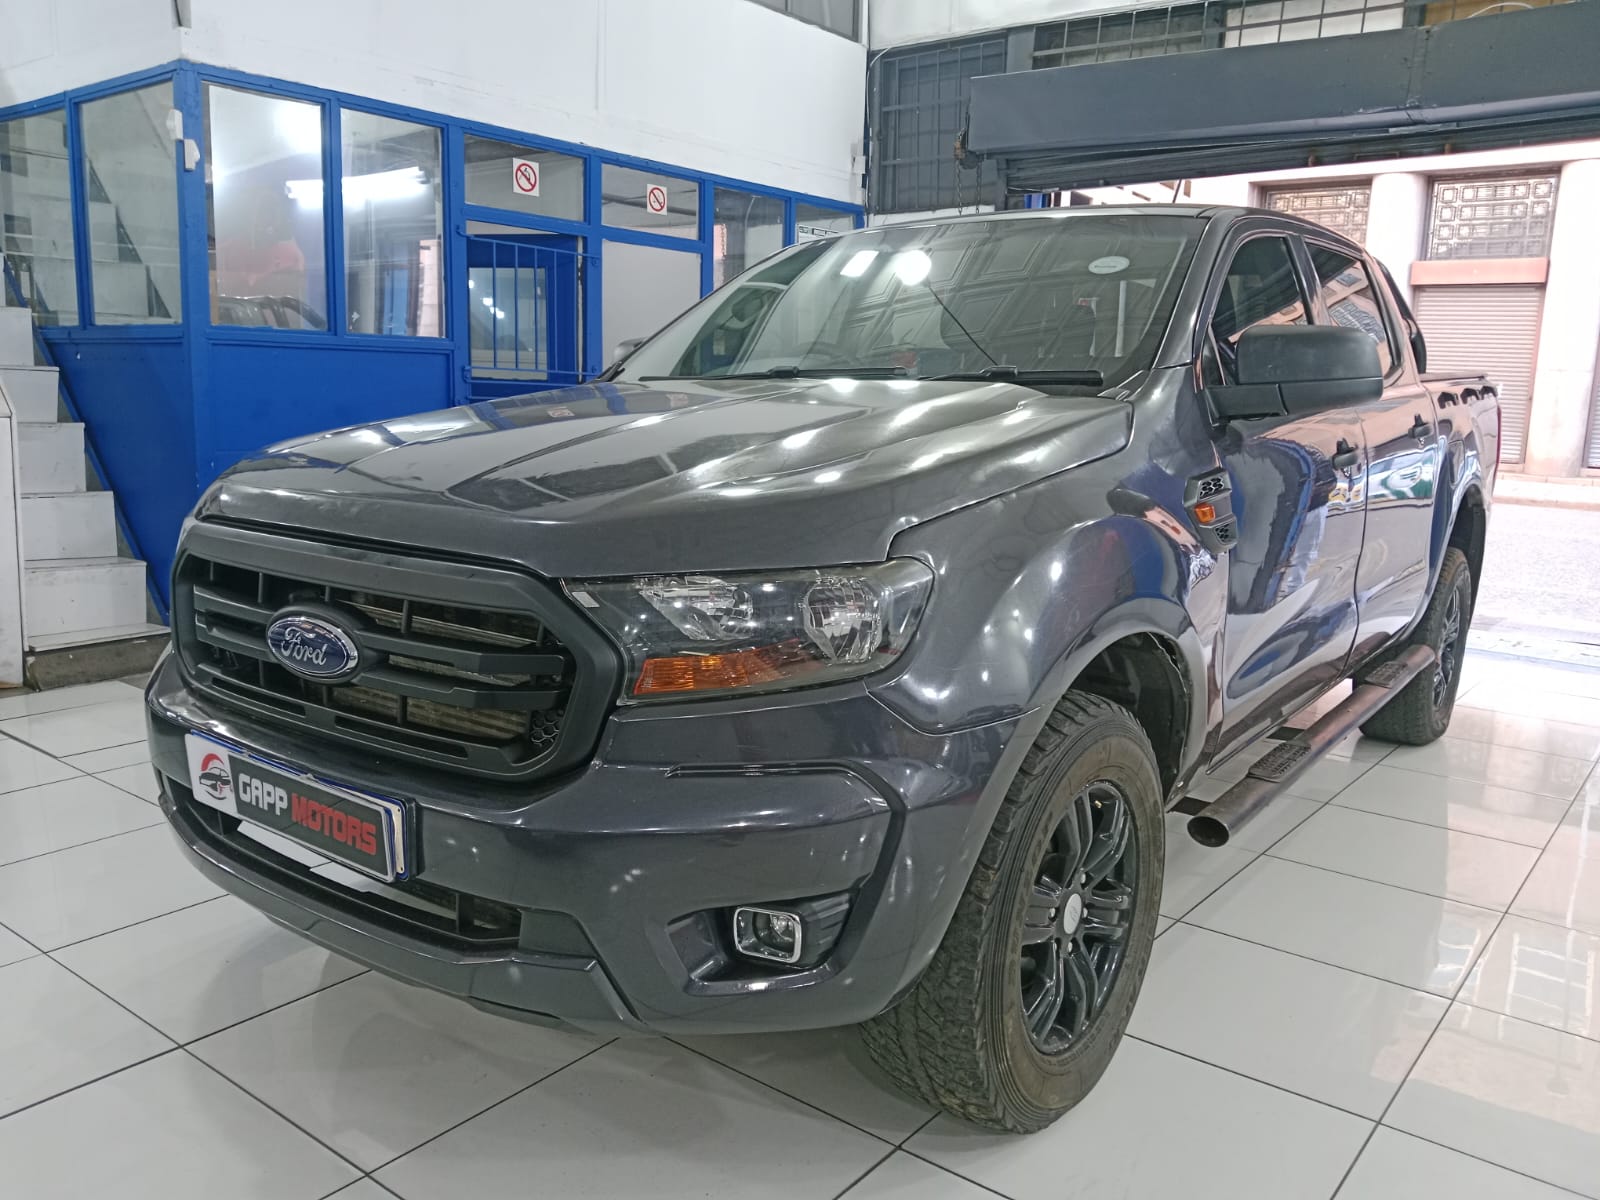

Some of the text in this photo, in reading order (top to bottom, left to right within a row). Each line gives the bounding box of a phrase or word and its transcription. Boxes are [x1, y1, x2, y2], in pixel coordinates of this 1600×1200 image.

[281, 627, 328, 666] Ford
[238, 773, 377, 856] GAPP MOTORS
